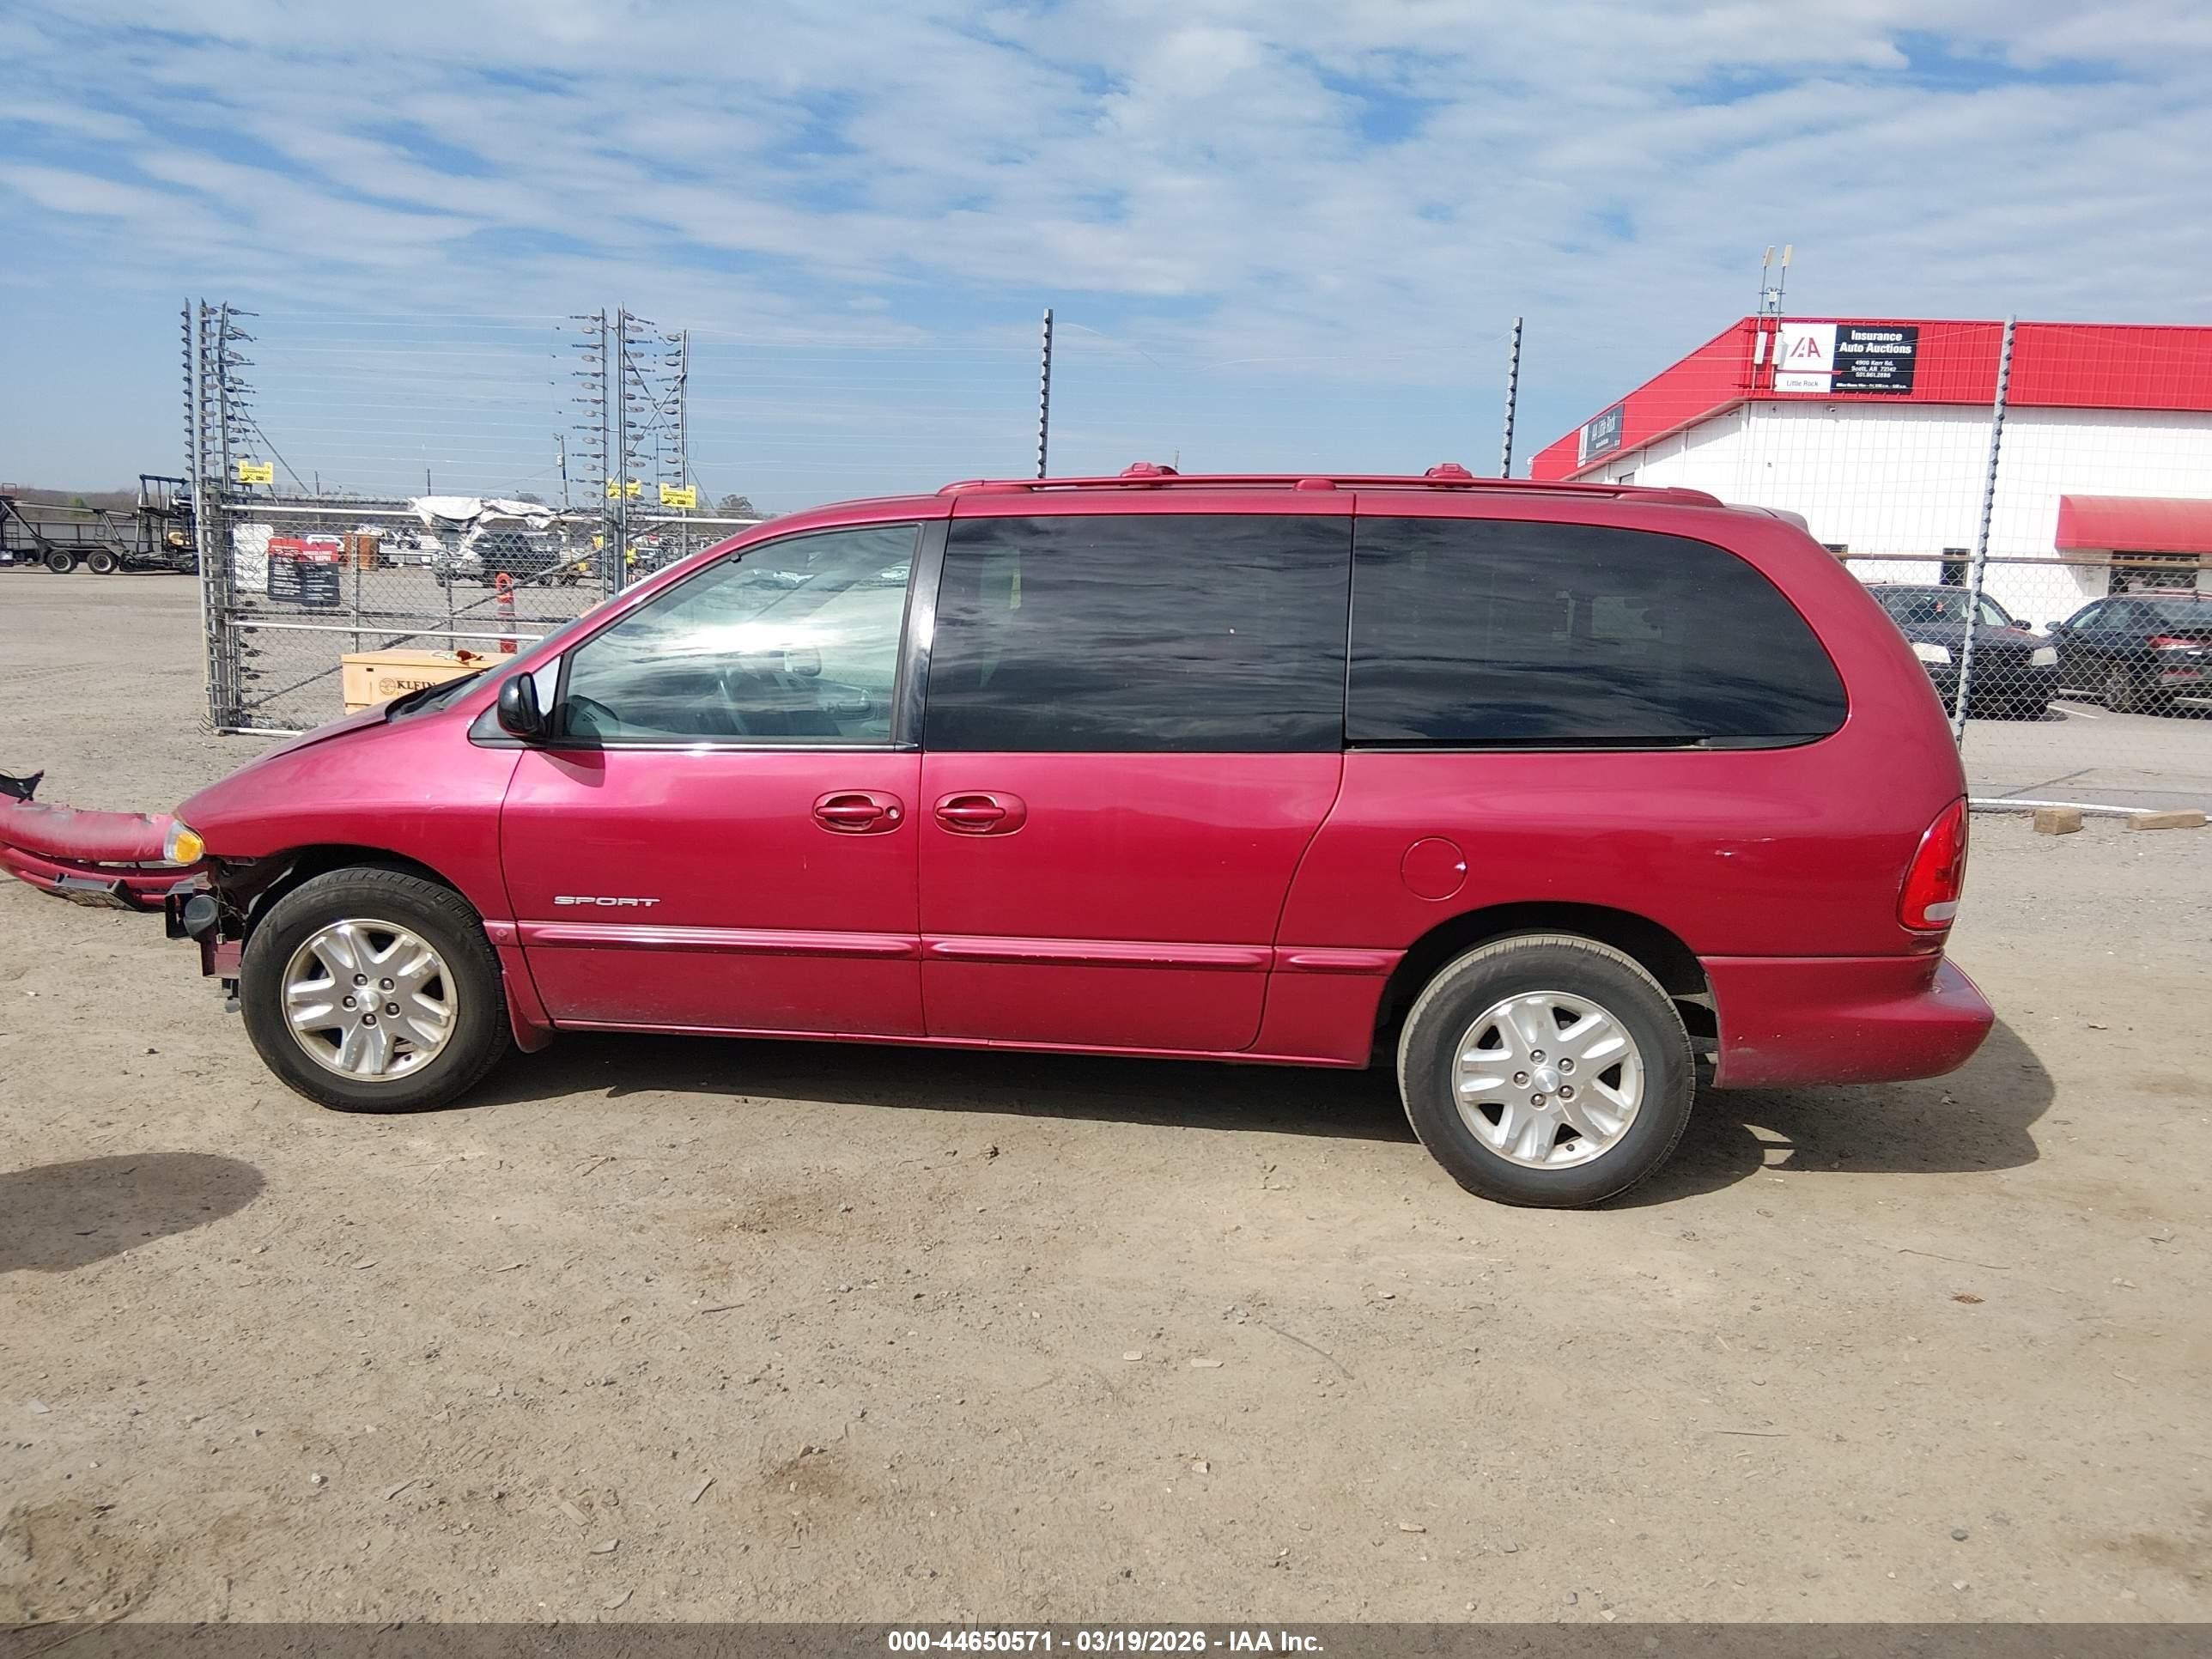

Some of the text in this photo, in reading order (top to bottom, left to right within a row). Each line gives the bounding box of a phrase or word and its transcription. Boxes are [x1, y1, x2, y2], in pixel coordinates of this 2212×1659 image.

[1850, 329, 1903, 342] Insurance
[1839, 342, 1911, 354] Auto Auctions
[554, 896, 660, 907] SPORT
